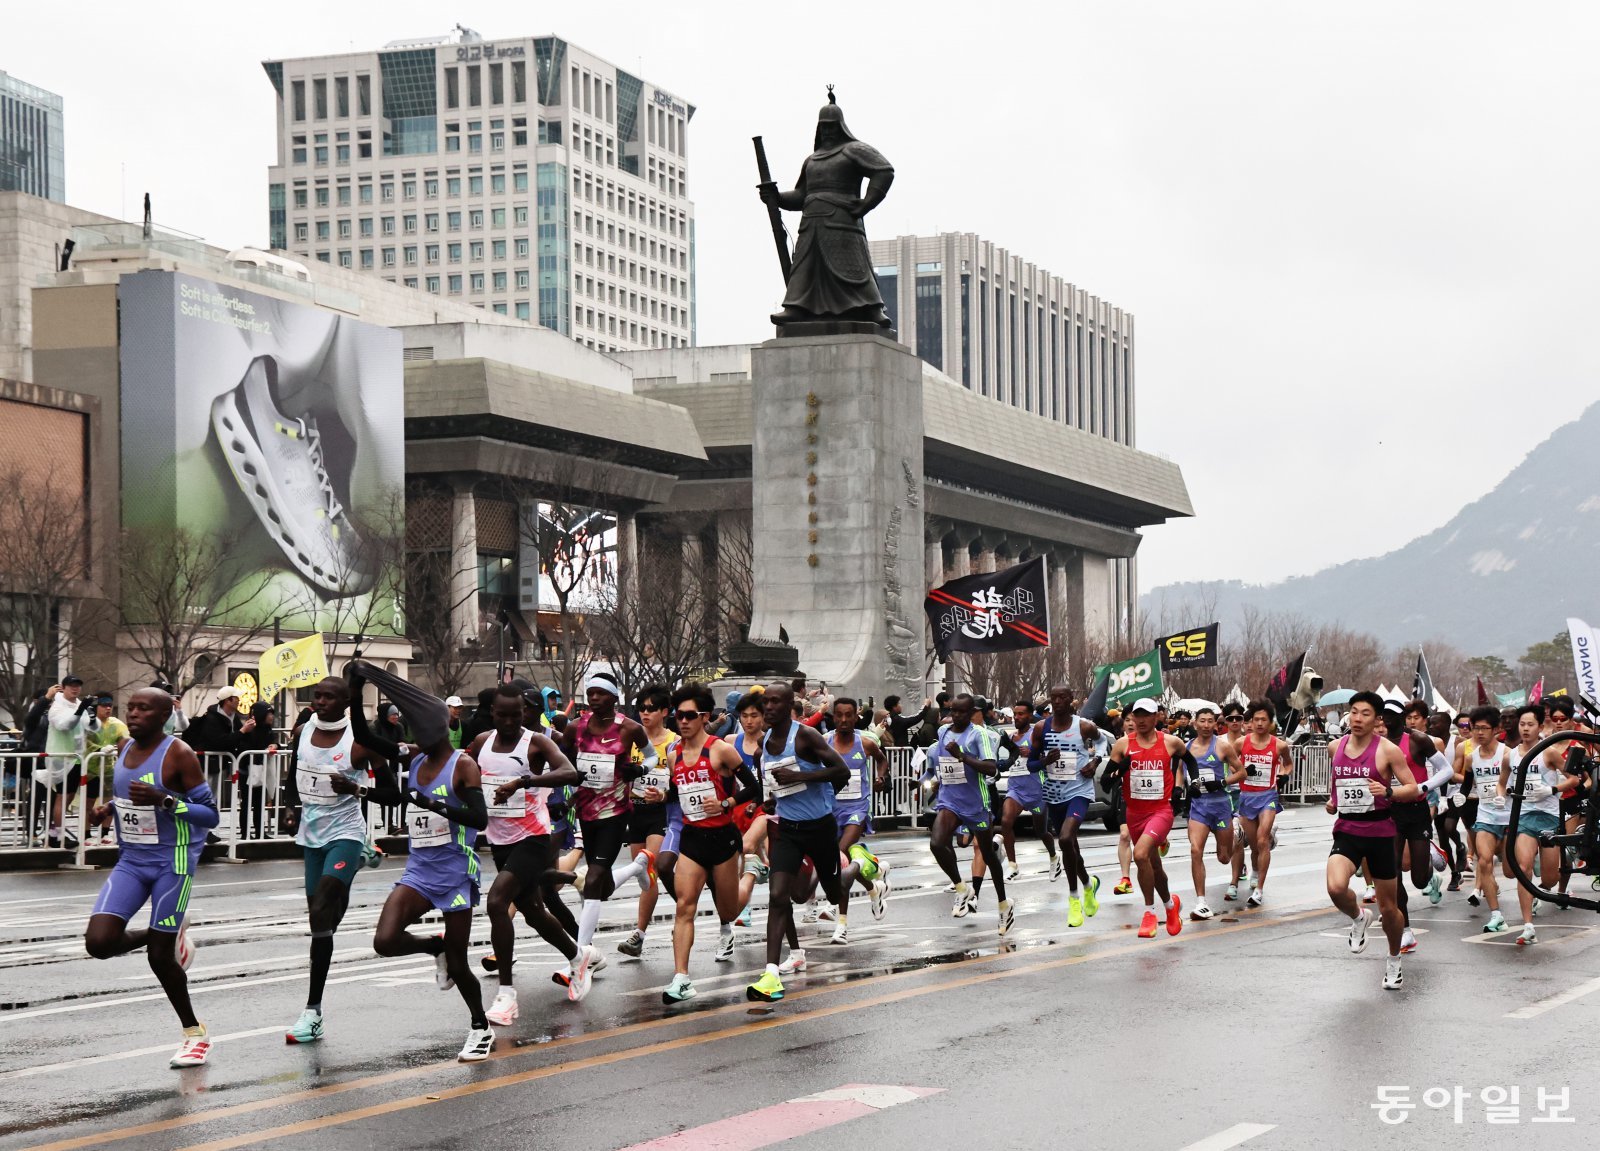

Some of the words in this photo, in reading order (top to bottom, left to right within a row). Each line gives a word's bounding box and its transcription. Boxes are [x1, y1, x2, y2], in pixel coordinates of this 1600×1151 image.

[456, 44, 495, 61] 외교부
[497, 47, 525, 57] MOFA
[180, 283, 201, 300] Soft
[202, 289, 210, 304] is
[211, 293, 256, 315] effortless.
[180, 301, 201, 317] Soft
[202, 307, 210, 320] is
[211, 309, 263, 333] Cloudsurfer
[590, 764, 597, 774] 6
[944, 765, 954, 774] 10
[1054, 760, 1066, 769] 15
[1130, 760, 1164, 770] CHINA
[676, 769, 710, 785] 코오롱
[1334, 766, 1370, 777] 영천시청
[311, 776, 318, 787] 7
[640, 776, 658, 786] 510
[1141, 779, 1153, 788] 18
[1344, 789, 1364, 799] 539
[689, 795, 703, 806] 91
[123, 813, 139, 826] 46
[415, 816, 429, 828] 47
